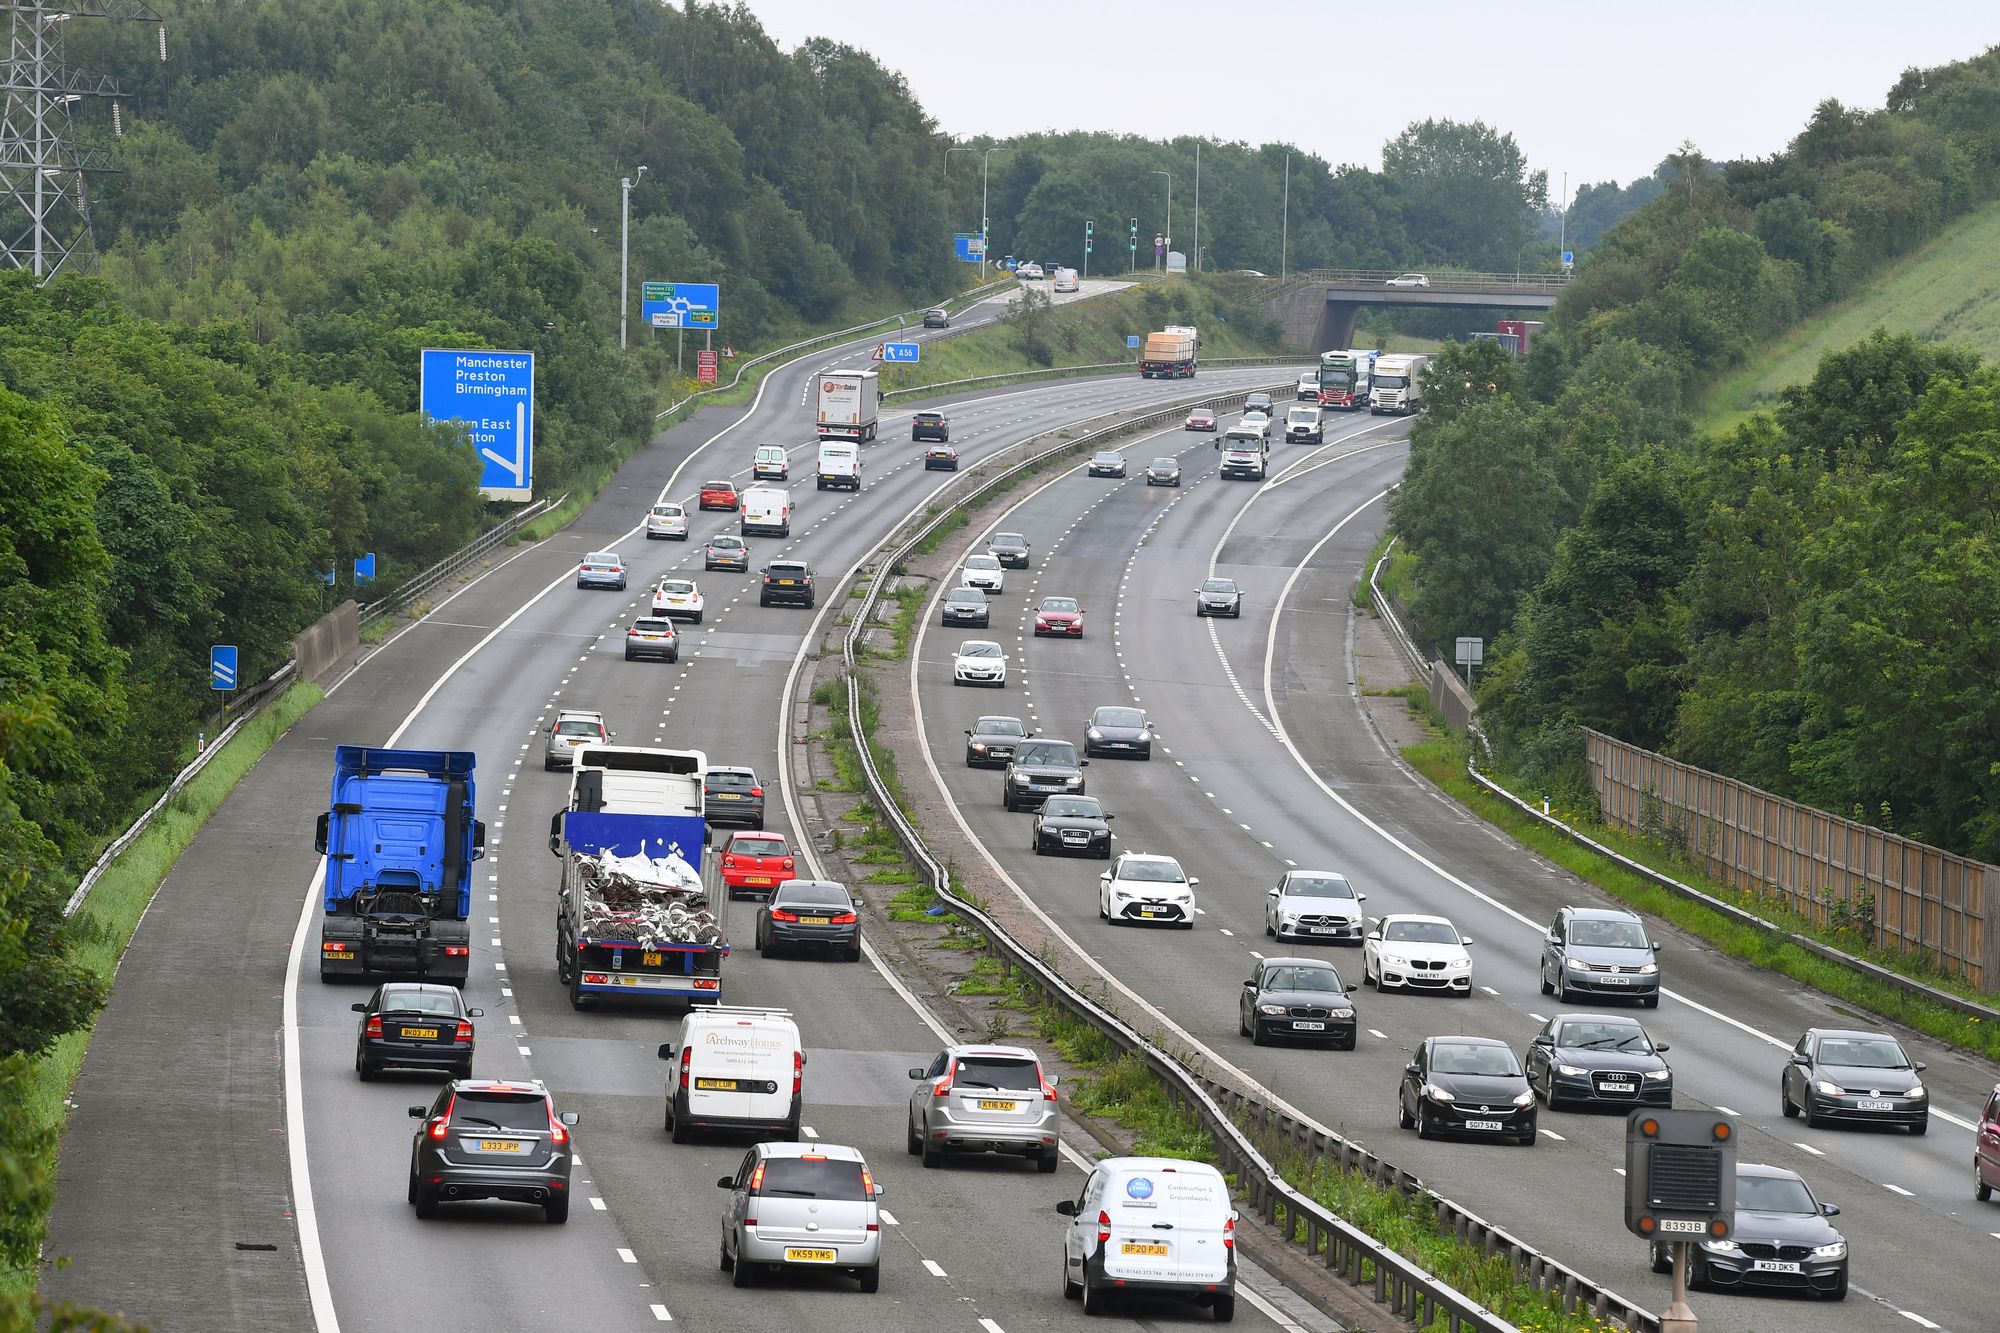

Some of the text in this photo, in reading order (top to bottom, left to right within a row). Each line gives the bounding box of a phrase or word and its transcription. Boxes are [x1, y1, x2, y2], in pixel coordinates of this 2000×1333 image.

[456, 356, 528, 369] Manchester
[455, 369, 506, 382] Preston
[455, 383, 527, 397] Birmingham
[481, 418, 511, 430] East
[404, 1028, 435, 1037] BK03 JTX
[982, 1101, 1014, 1110] KT16 XZY
[481, 1141, 519, 1151] L333 JPP
[1167, 1184, 1207, 1192] Construction
[1169, 1194, 1212, 1202] Groundworks
[1665, 1221, 1701, 1231] 8393B
[791, 1248, 831, 1259] YK59 YMS
[1125, 1244, 1147, 1253] BF20
[1760, 1262, 1776, 1270] M33
